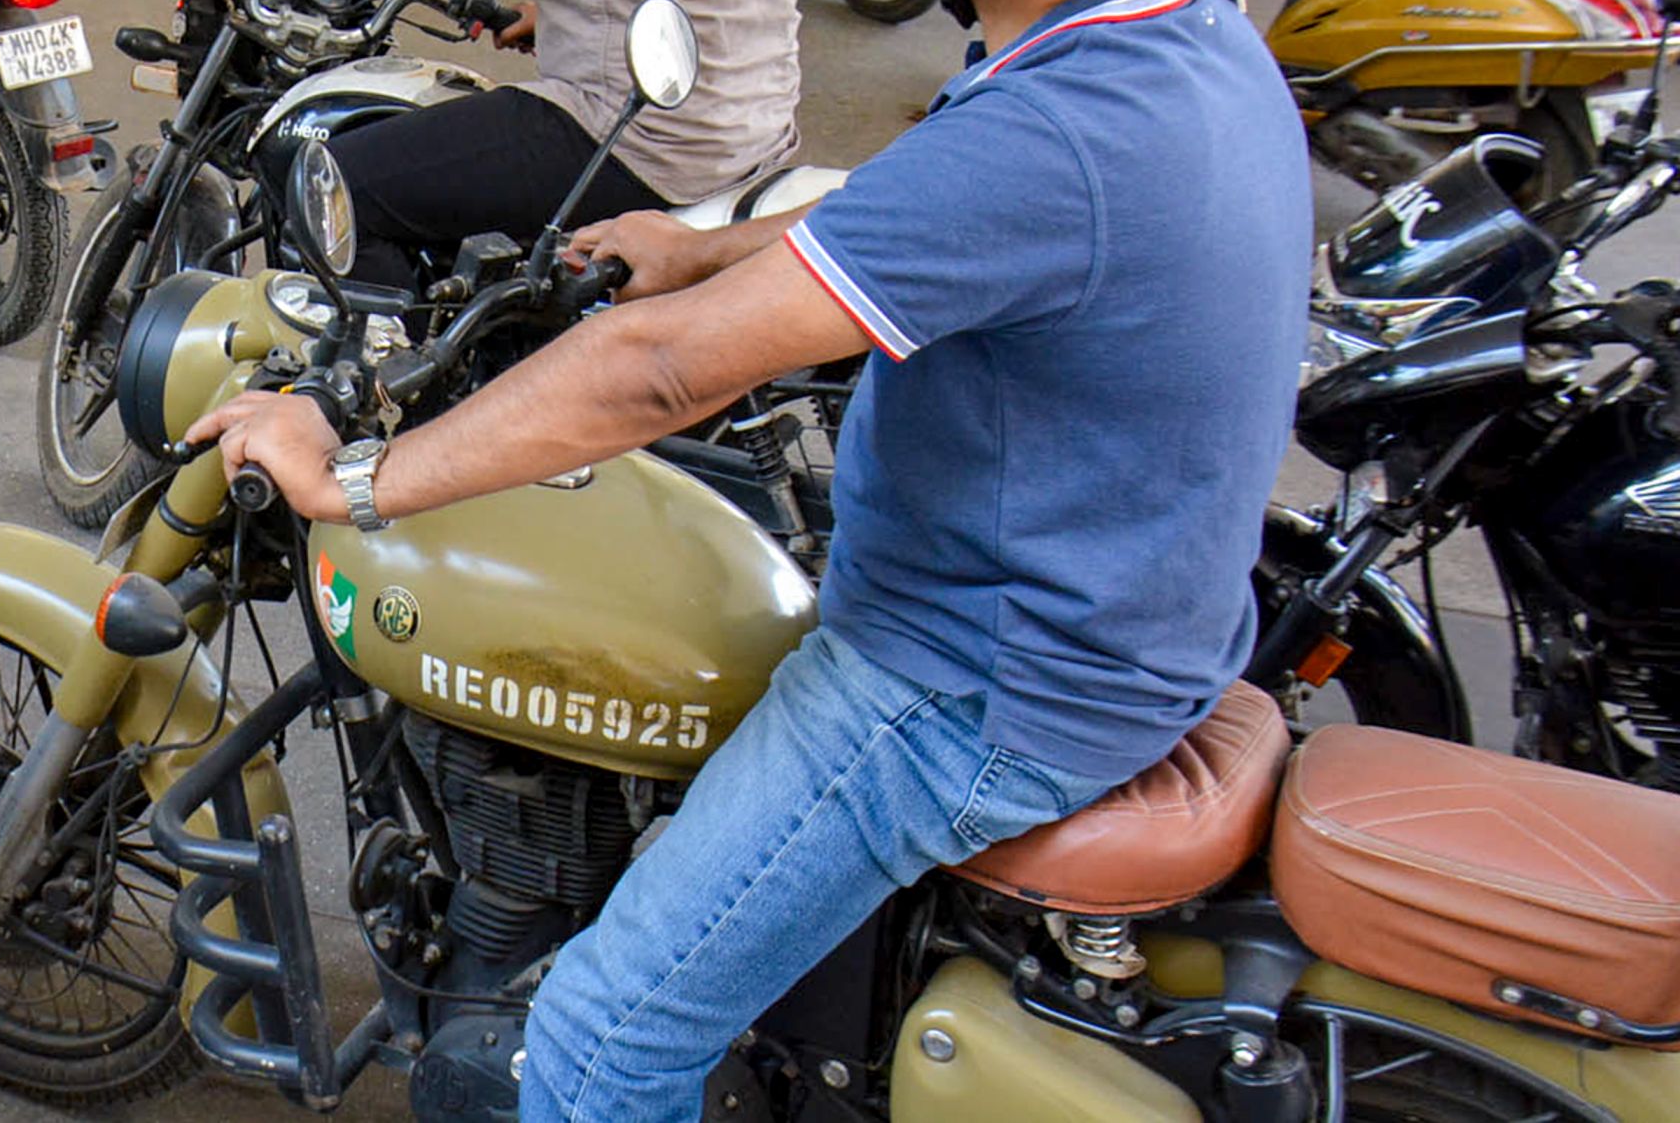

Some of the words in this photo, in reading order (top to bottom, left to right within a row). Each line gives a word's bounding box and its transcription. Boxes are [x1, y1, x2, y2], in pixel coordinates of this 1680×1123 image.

[9, 22, 74, 56] MH04K
[291, 122, 330, 141] Hero
[421, 653, 711, 749] RE005925
